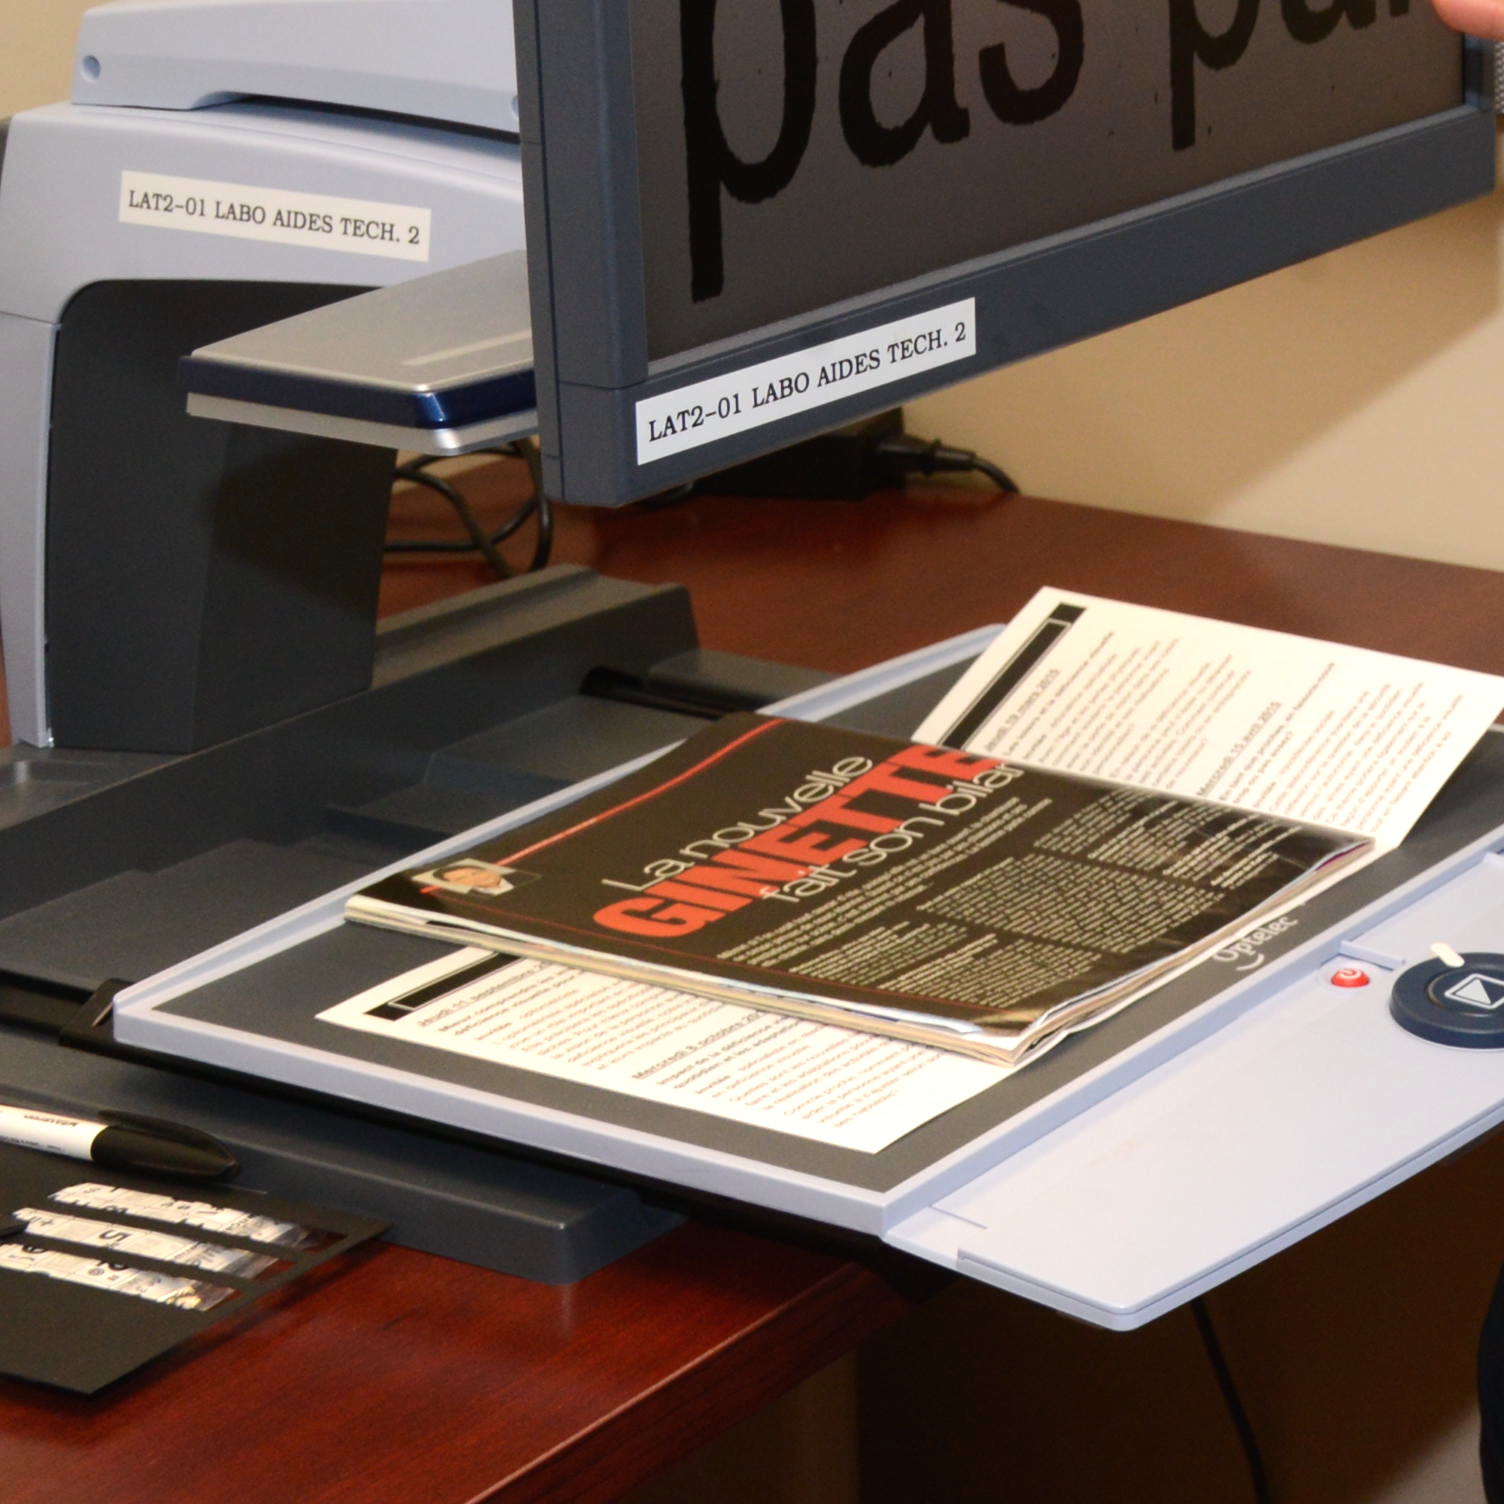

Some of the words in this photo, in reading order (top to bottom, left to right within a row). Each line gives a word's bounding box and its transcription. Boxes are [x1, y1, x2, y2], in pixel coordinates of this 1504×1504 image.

[128, 190, 206, 218] LAT2-01
[214, 200, 267, 226] LABO
[273, 209, 334, 235] AIDES
[339, 217, 400, 243] TECH.
[408, 226, 420, 245] 2
[647, 390, 744, 444] LAT2-01
[750, 372, 811, 412] LABO
[815, 352, 882, 393] AIDES
[886, 332, 949, 373] TECH.
[953, 321, 967, 346] 2
[593, 743, 1003, 938] GINETTE
[602, 858, 690, 893] La
[679, 755, 874, 860] nouvelle
[759, 863, 844, 903] fait
[842, 816, 945, 867] son
[1211, 913, 1298, 964] Optelec
